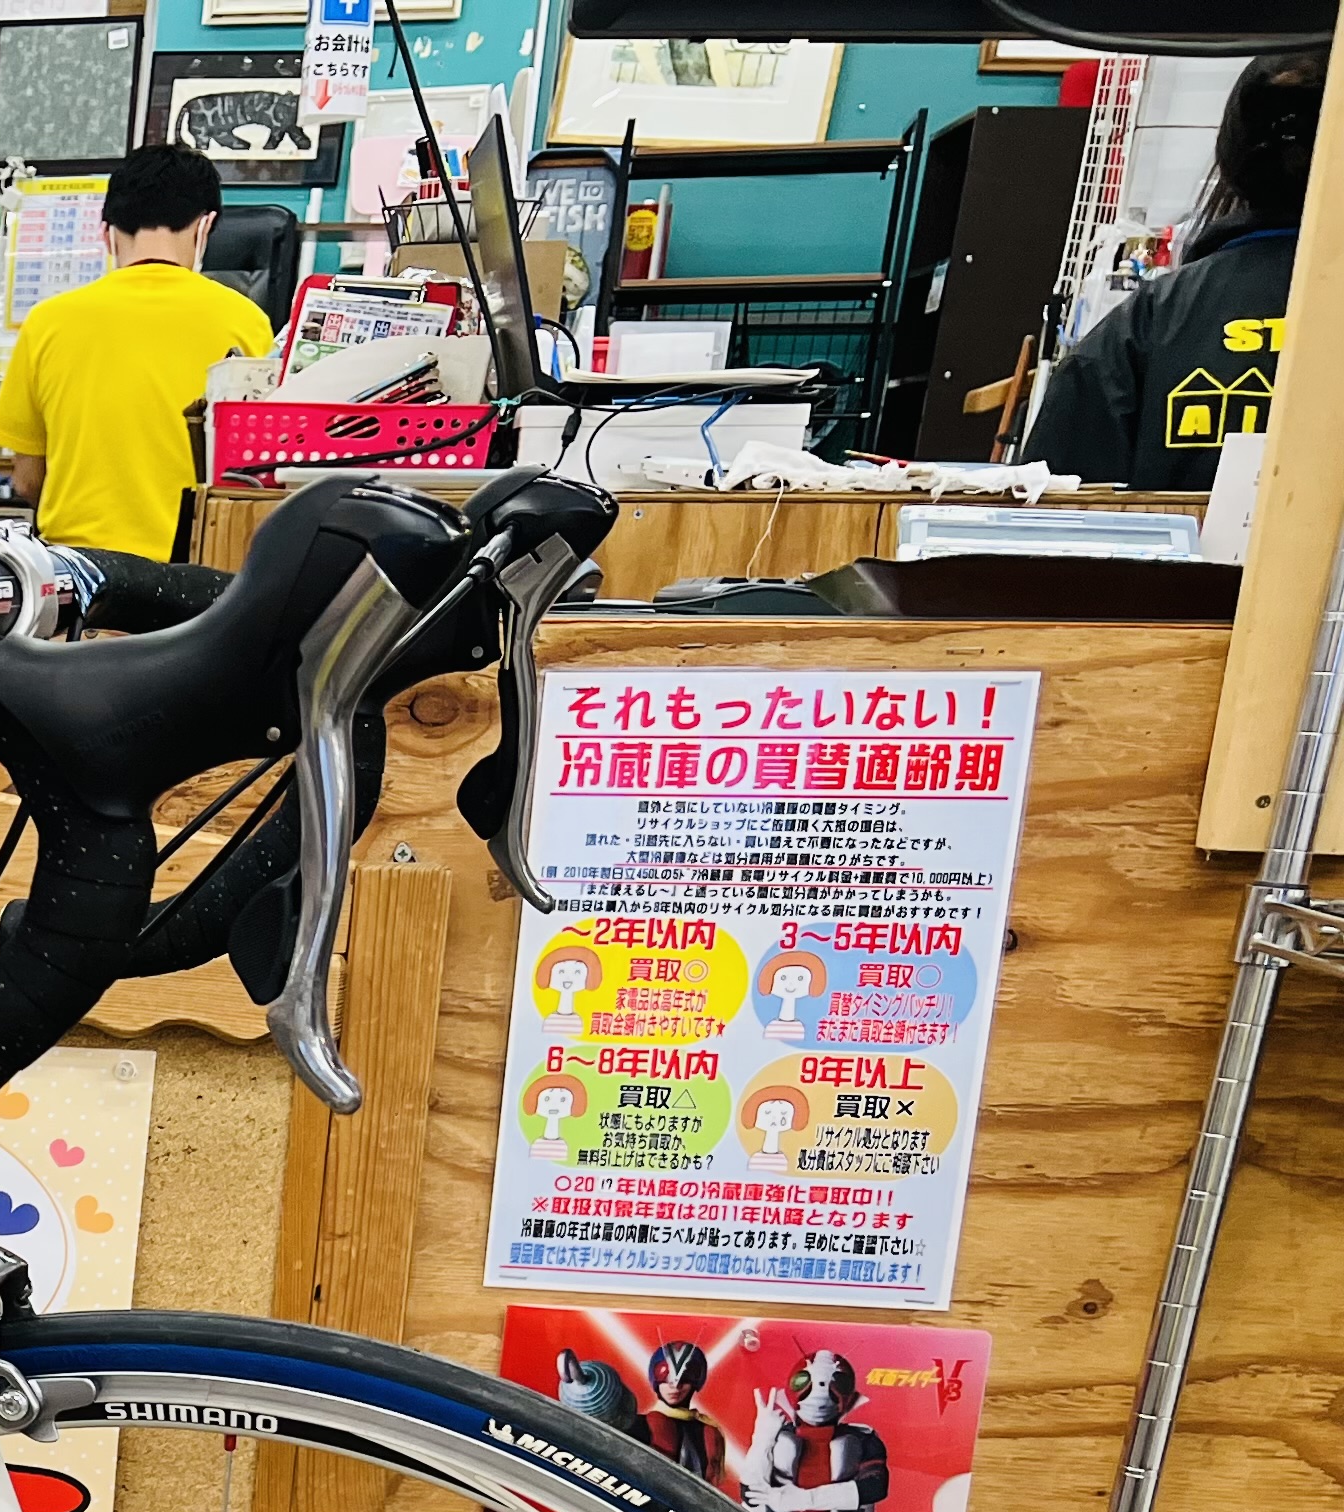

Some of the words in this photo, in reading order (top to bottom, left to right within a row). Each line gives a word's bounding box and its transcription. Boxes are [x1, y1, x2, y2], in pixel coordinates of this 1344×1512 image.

[314, 33, 370, 53] お会計は
[313, 61, 369, 78] こちらです
[566, 685, 997, 732] それもったいない！
[558, 742, 1005, 792] 冷蔵庫の買替適齢期
[552, 899, 982, 920] 替目安は購入から8年以内のリサイクル処分になる前に買替がおすすめです！
[615, 987, 708, 1013] 家電品は高年式が
[828, 992, 955, 1019] 買替タイミングバッチリ！
[815, 1018, 960, 1045] まだまだ買取金額付きます！
[546, 1045, 719, 1081] 6～8年以内
[799, 1056, 927, 1091] 9年以上
[598, 1112, 704, 1133] 状態にもよりますが
[815, 1127, 930, 1152] リサイクル処分となります
[576, 1148, 714, 1171] 無料引上げはできるかも？
[797, 1148, 940, 1176] 処分費はスタッフにご相談下さい
[104, 1403, 280, 1435] SHIMANO
[516, 1432, 653, 1508] MICHELIN
